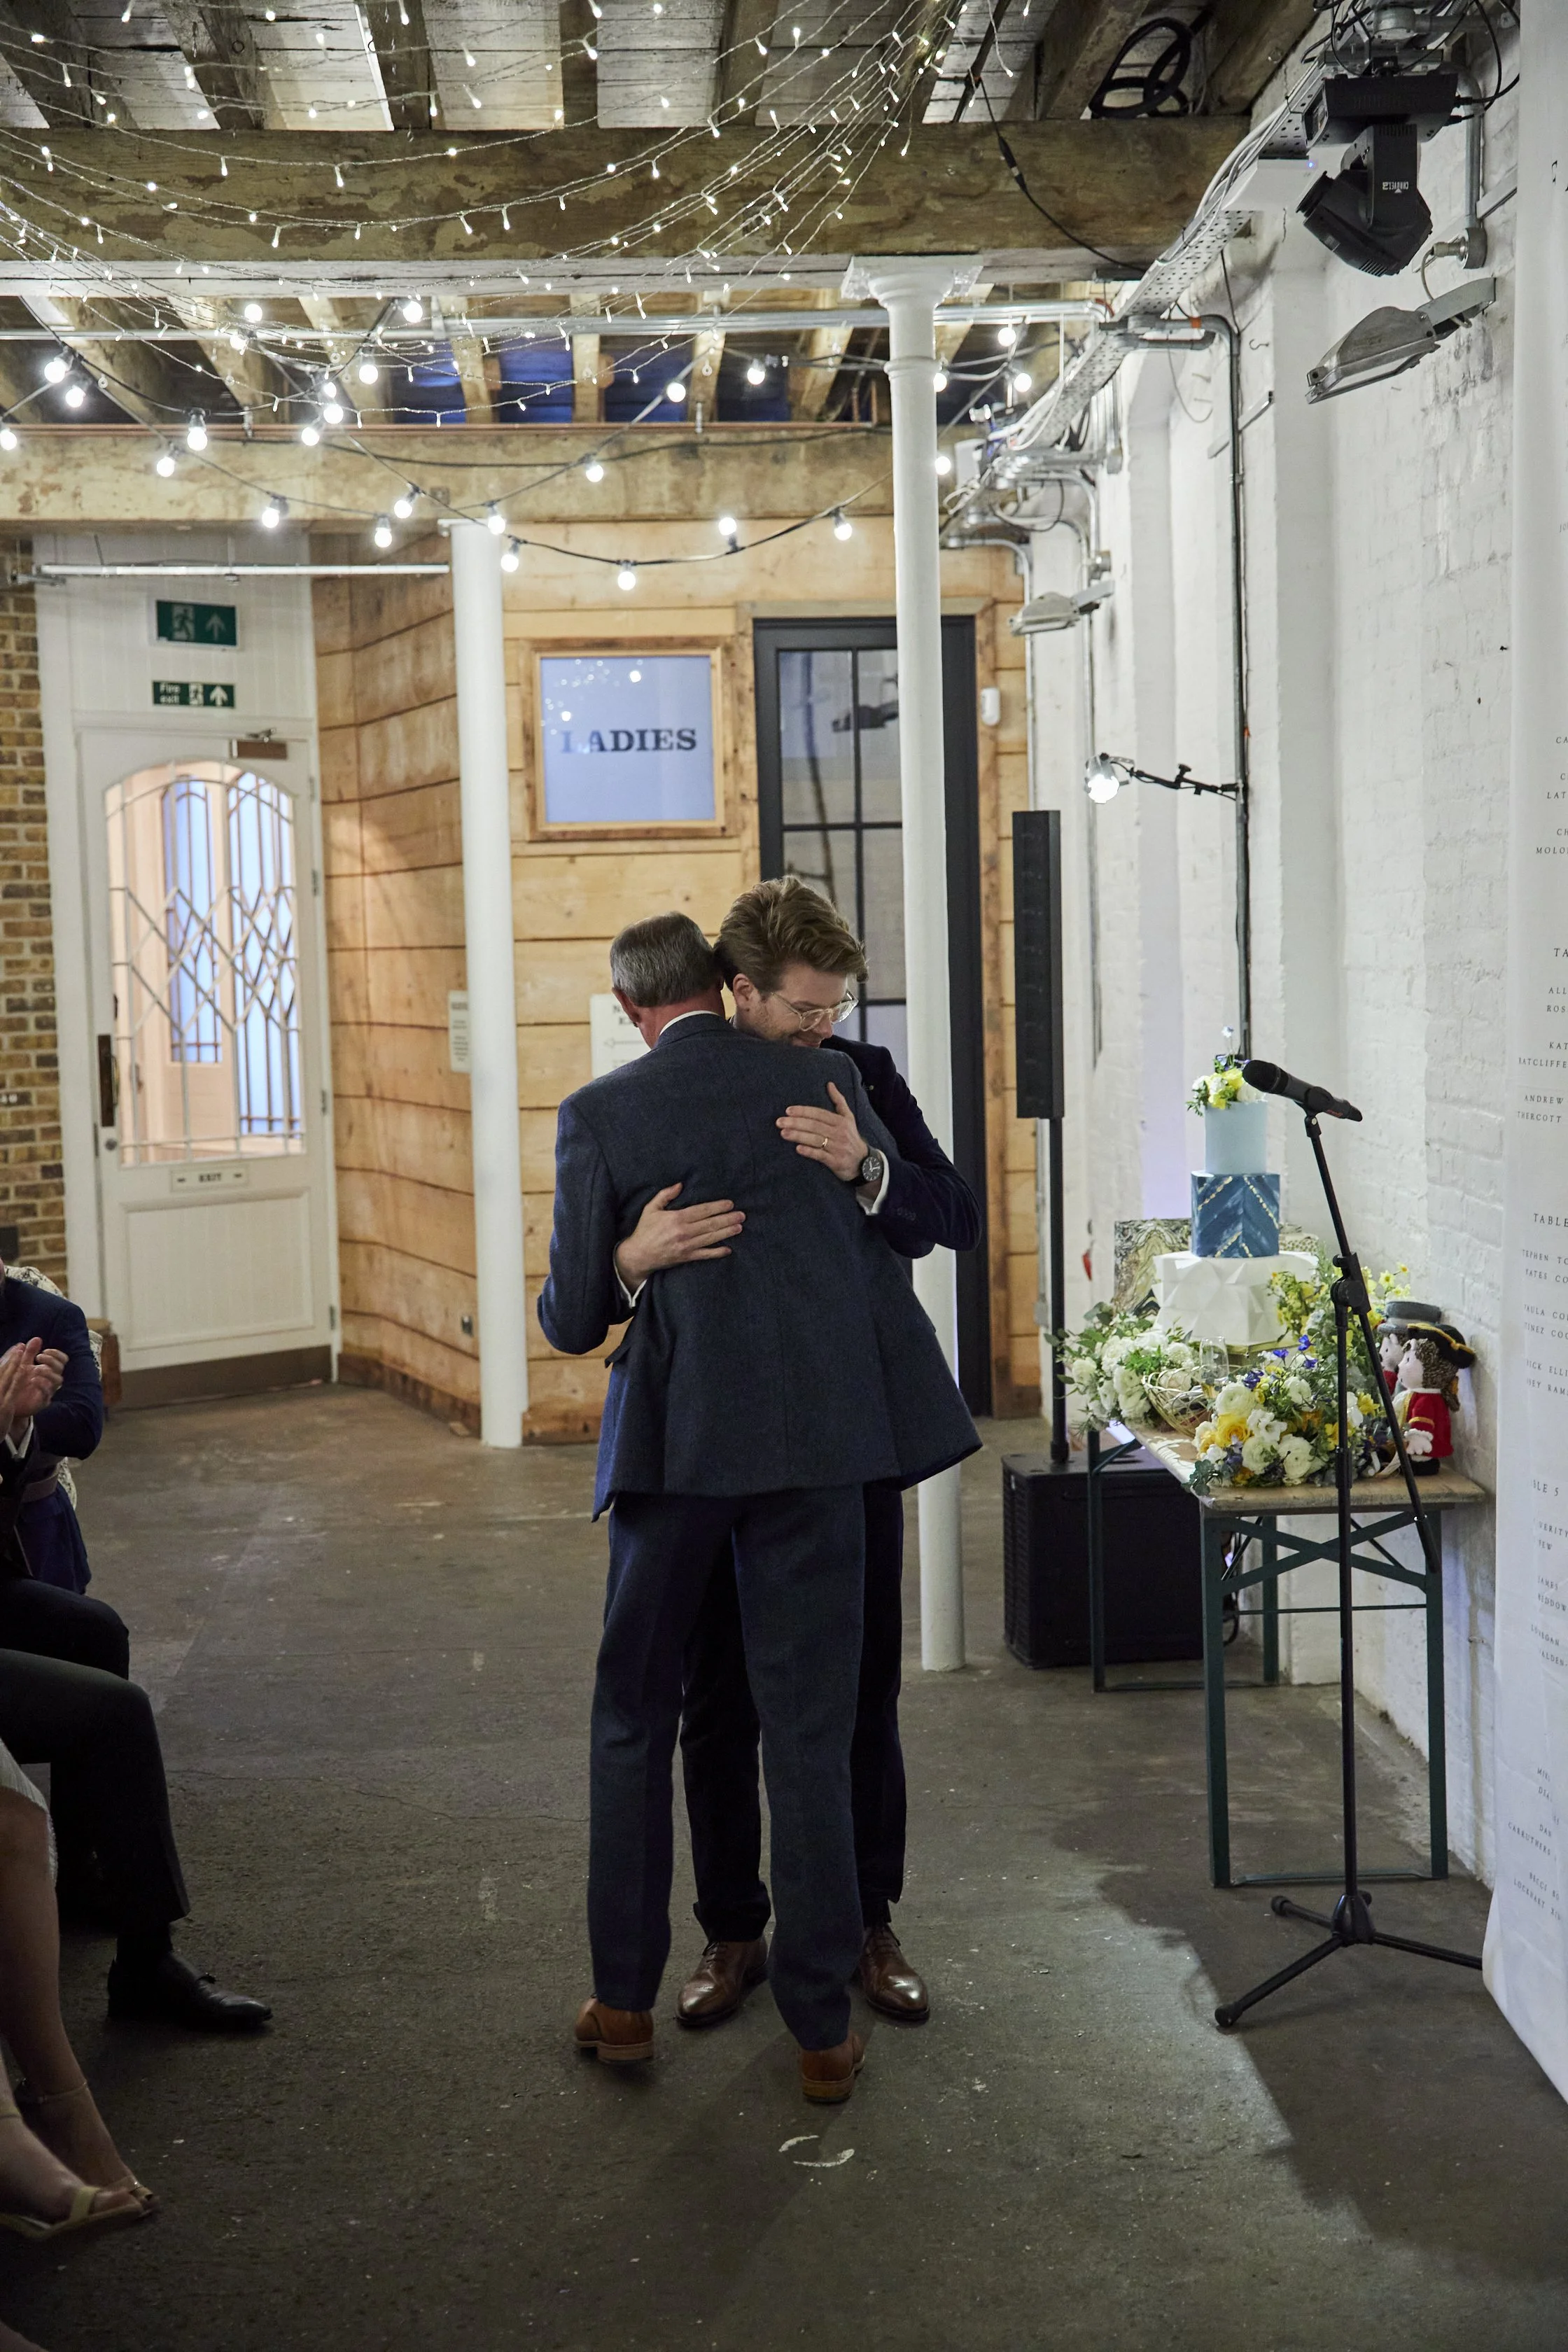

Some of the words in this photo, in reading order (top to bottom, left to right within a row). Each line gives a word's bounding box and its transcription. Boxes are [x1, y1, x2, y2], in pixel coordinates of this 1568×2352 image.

[160, 683, 180, 693] Fire
[160, 695, 179, 704] exit
[1524, 1095, 1564, 1105] ANDREW
[1534, 1213, 1568, 1227] TABLE
